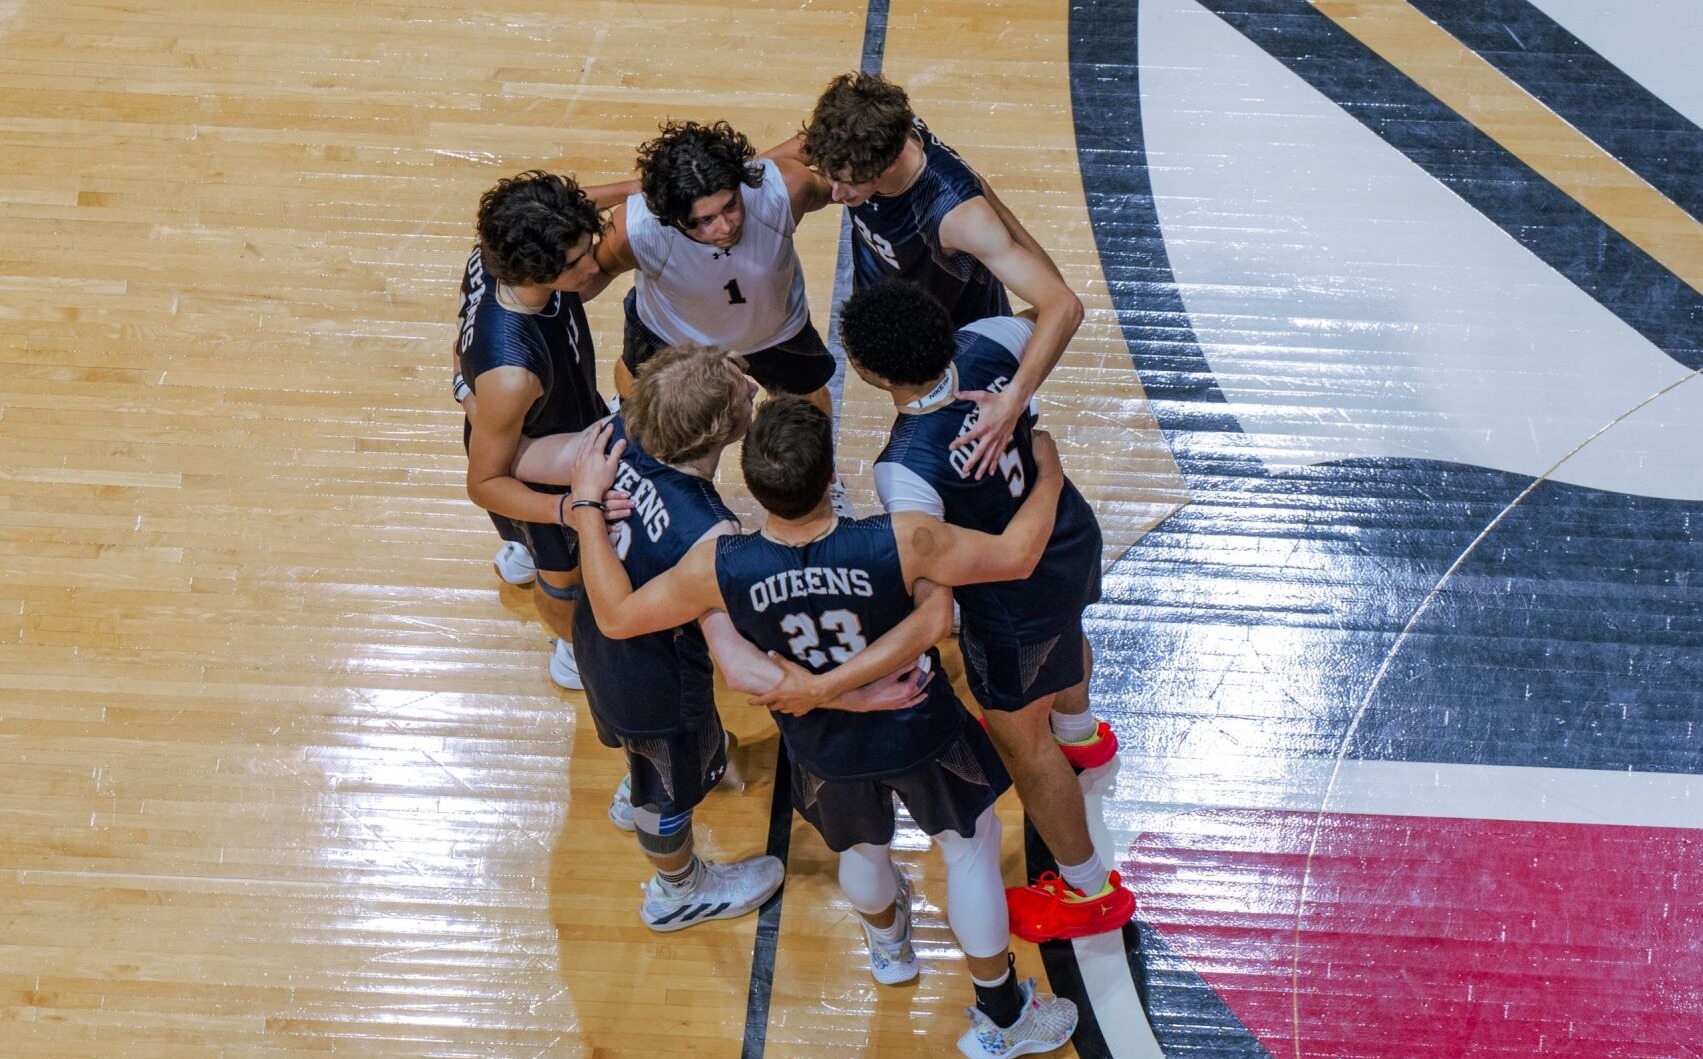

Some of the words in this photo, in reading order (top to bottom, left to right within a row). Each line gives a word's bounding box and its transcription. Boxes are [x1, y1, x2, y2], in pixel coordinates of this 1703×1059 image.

[723, 278, 747, 305] 1
[749, 567, 874, 613] QUEENS
[780, 608, 868, 669] 23
